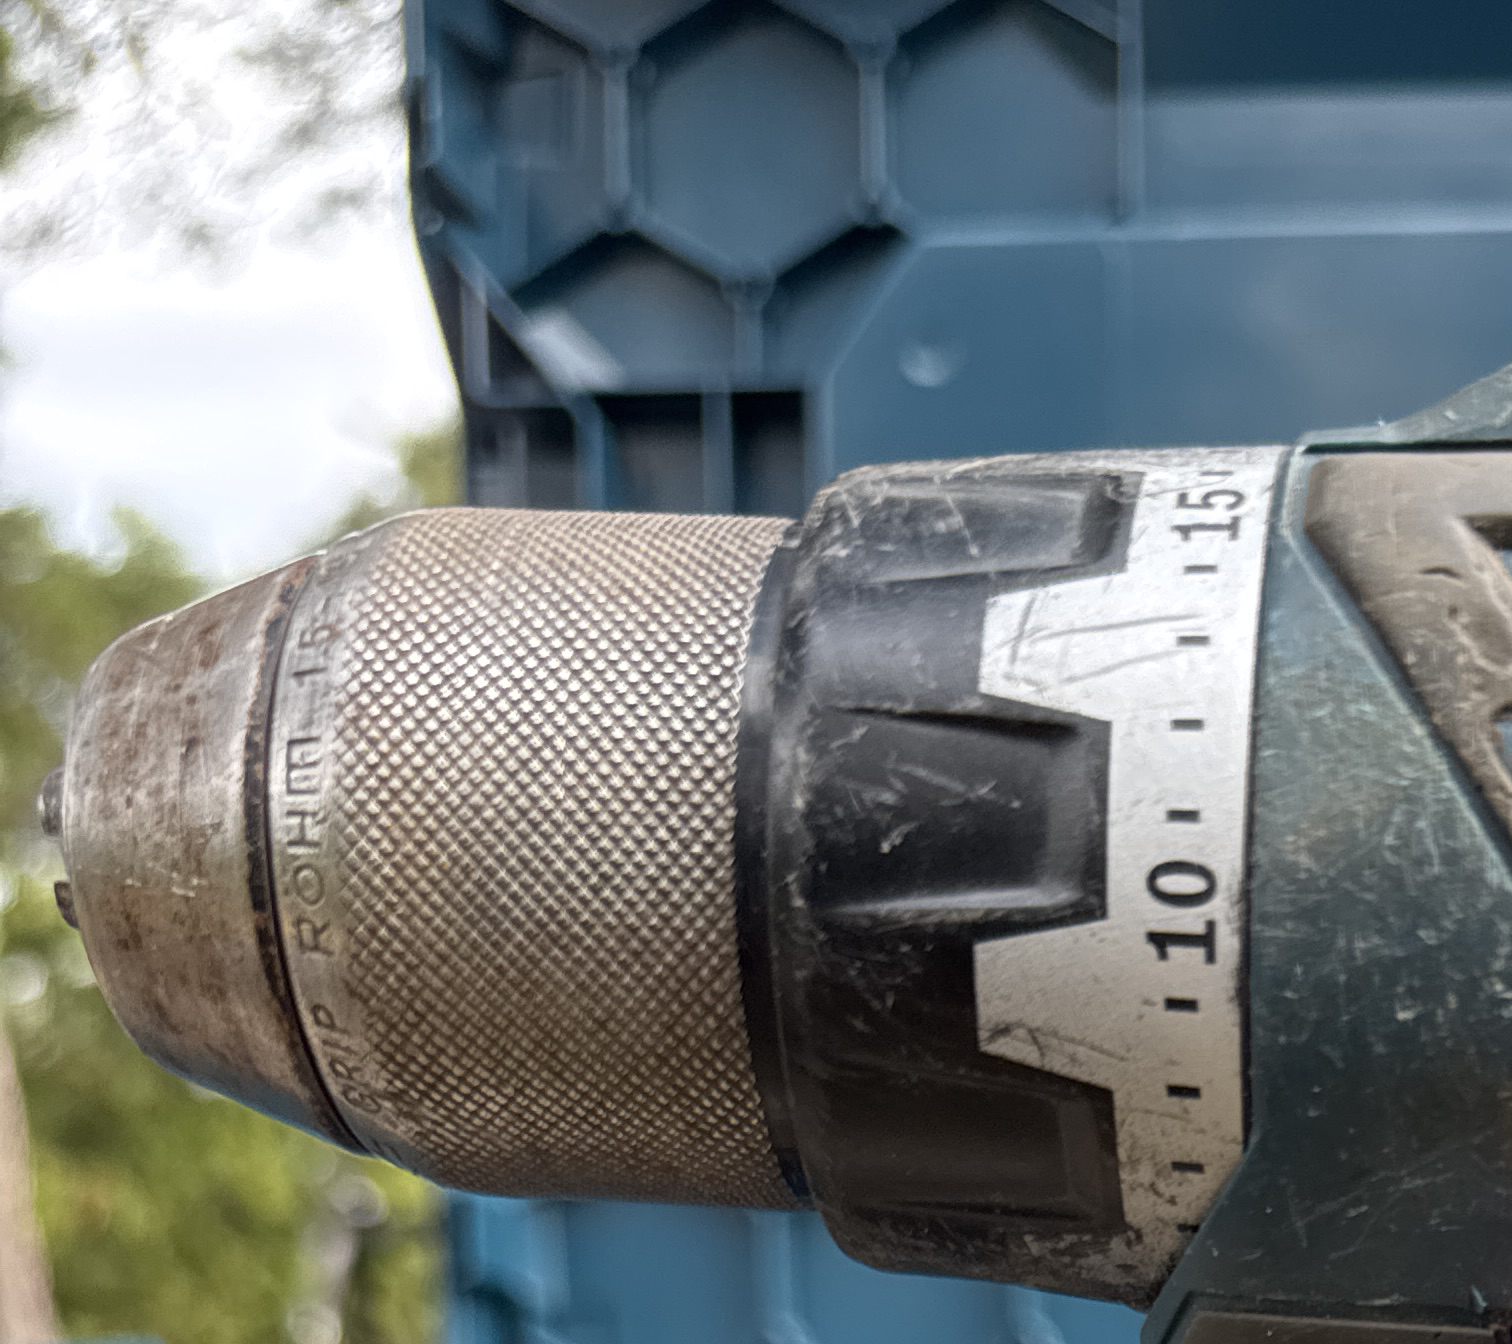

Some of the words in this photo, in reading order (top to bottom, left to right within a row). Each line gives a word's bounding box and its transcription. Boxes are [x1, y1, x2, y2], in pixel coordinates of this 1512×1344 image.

[1171, 485, 1245, 543] 15
[1146, 859, 1217, 965] 10
[311, 1003, 382, 1114] GRIP
